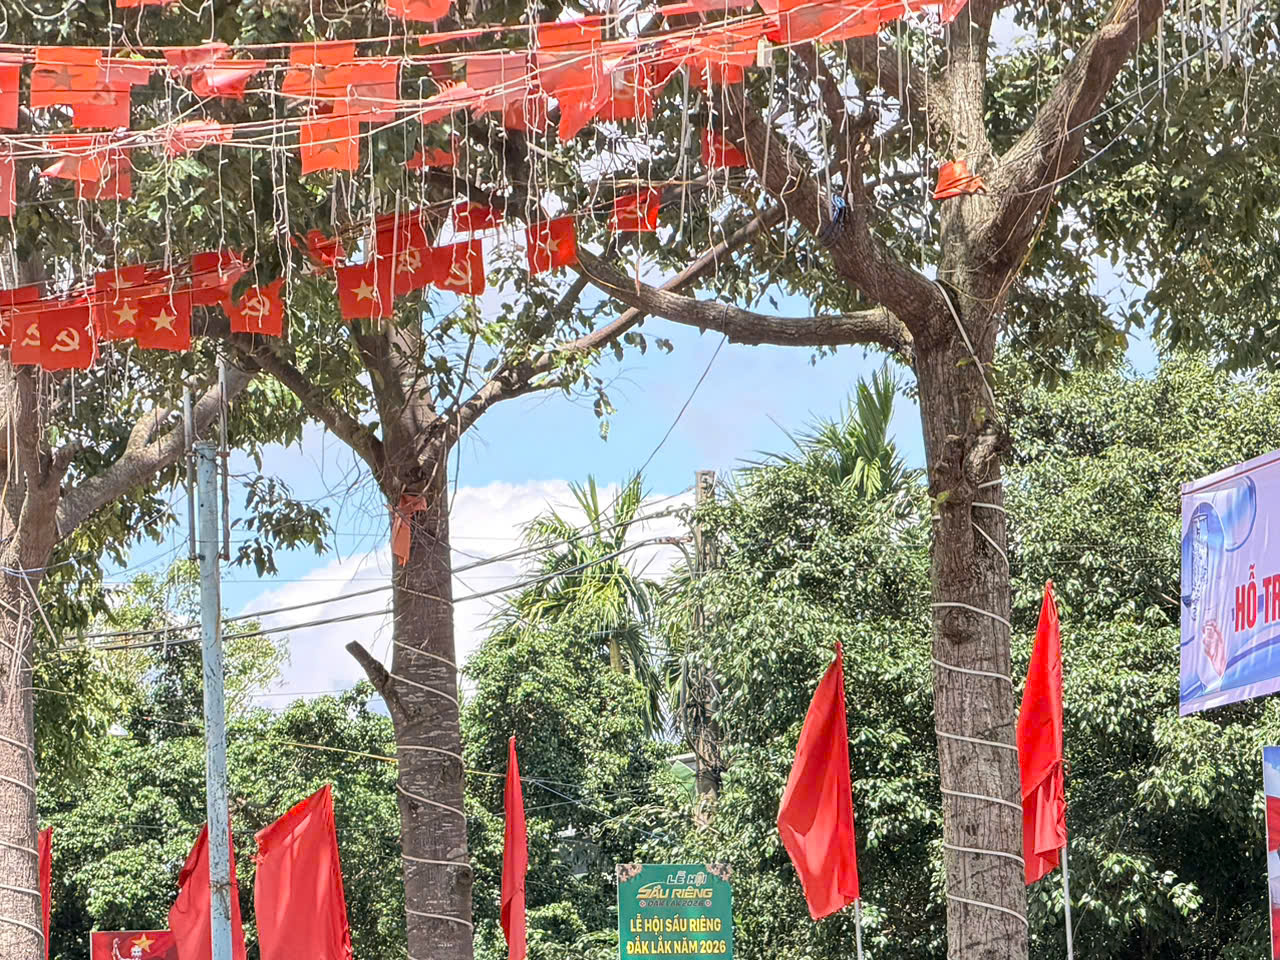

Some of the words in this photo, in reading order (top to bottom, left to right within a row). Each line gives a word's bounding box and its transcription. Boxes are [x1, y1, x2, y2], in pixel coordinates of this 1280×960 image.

[1235, 563, 1257, 632] HỖ
[671, 886, 713, 899] RIÊNG
[630, 913, 643, 932] LỄ
[644, 915, 664, 935] HỘI
[689, 915, 721, 932] RIÊNG
[626, 935, 649, 955] ĐẮK
[651, 935, 672, 954] LẮK
[674, 937, 698, 954] NĂM
[699, 939, 726, 954] 2026
